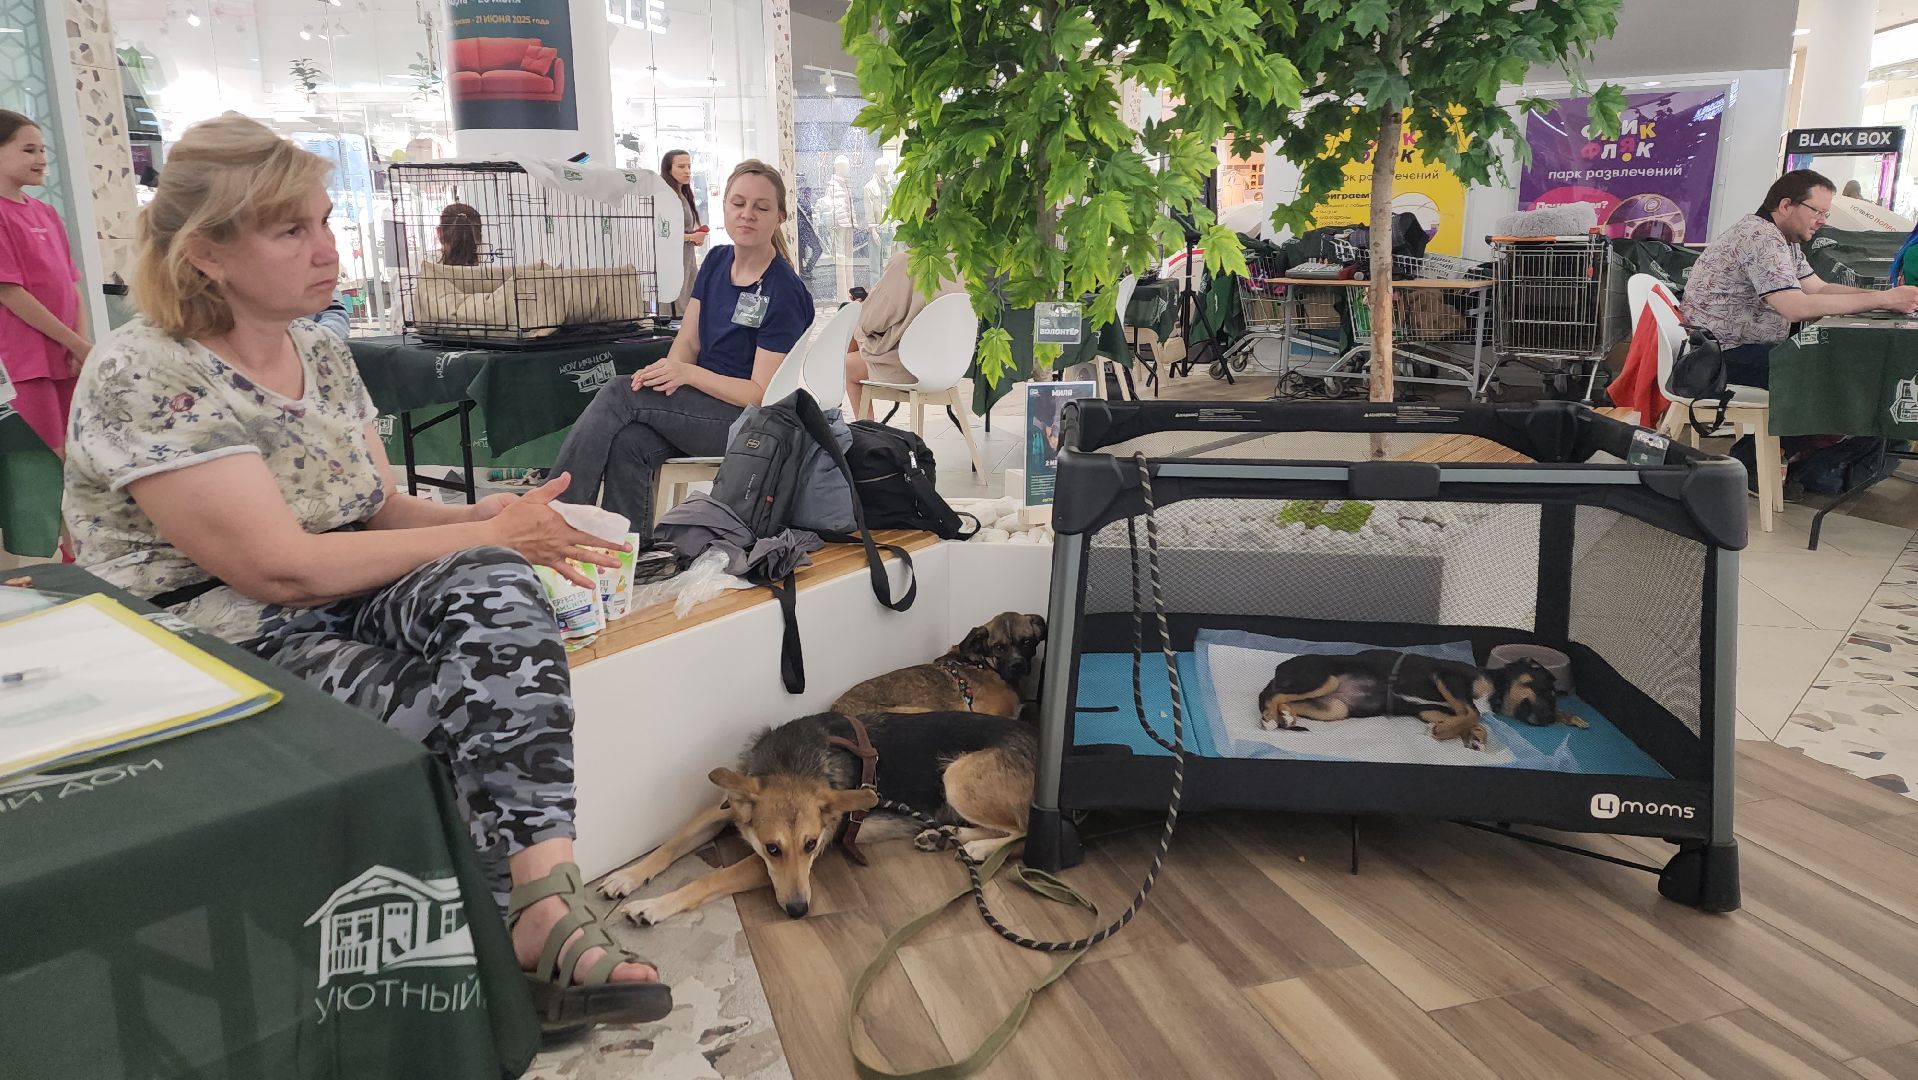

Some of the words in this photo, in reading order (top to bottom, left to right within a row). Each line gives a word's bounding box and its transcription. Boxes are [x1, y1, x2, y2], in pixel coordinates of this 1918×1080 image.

[1581, 119, 1656, 141] ИК
[1799, 132, 1853, 147] BLACK
[1857, 131, 1893, 146] BOX
[1359, 169, 1439, 183] раечений
[1549, 169, 1582, 181] парк
[1586, 164, 1683, 181] развлечений
[58, 758, 164, 799] ДОМ
[1590, 793, 1696, 819] 4moms
[315, 973, 481, 1024] УЮТНЫЙ
